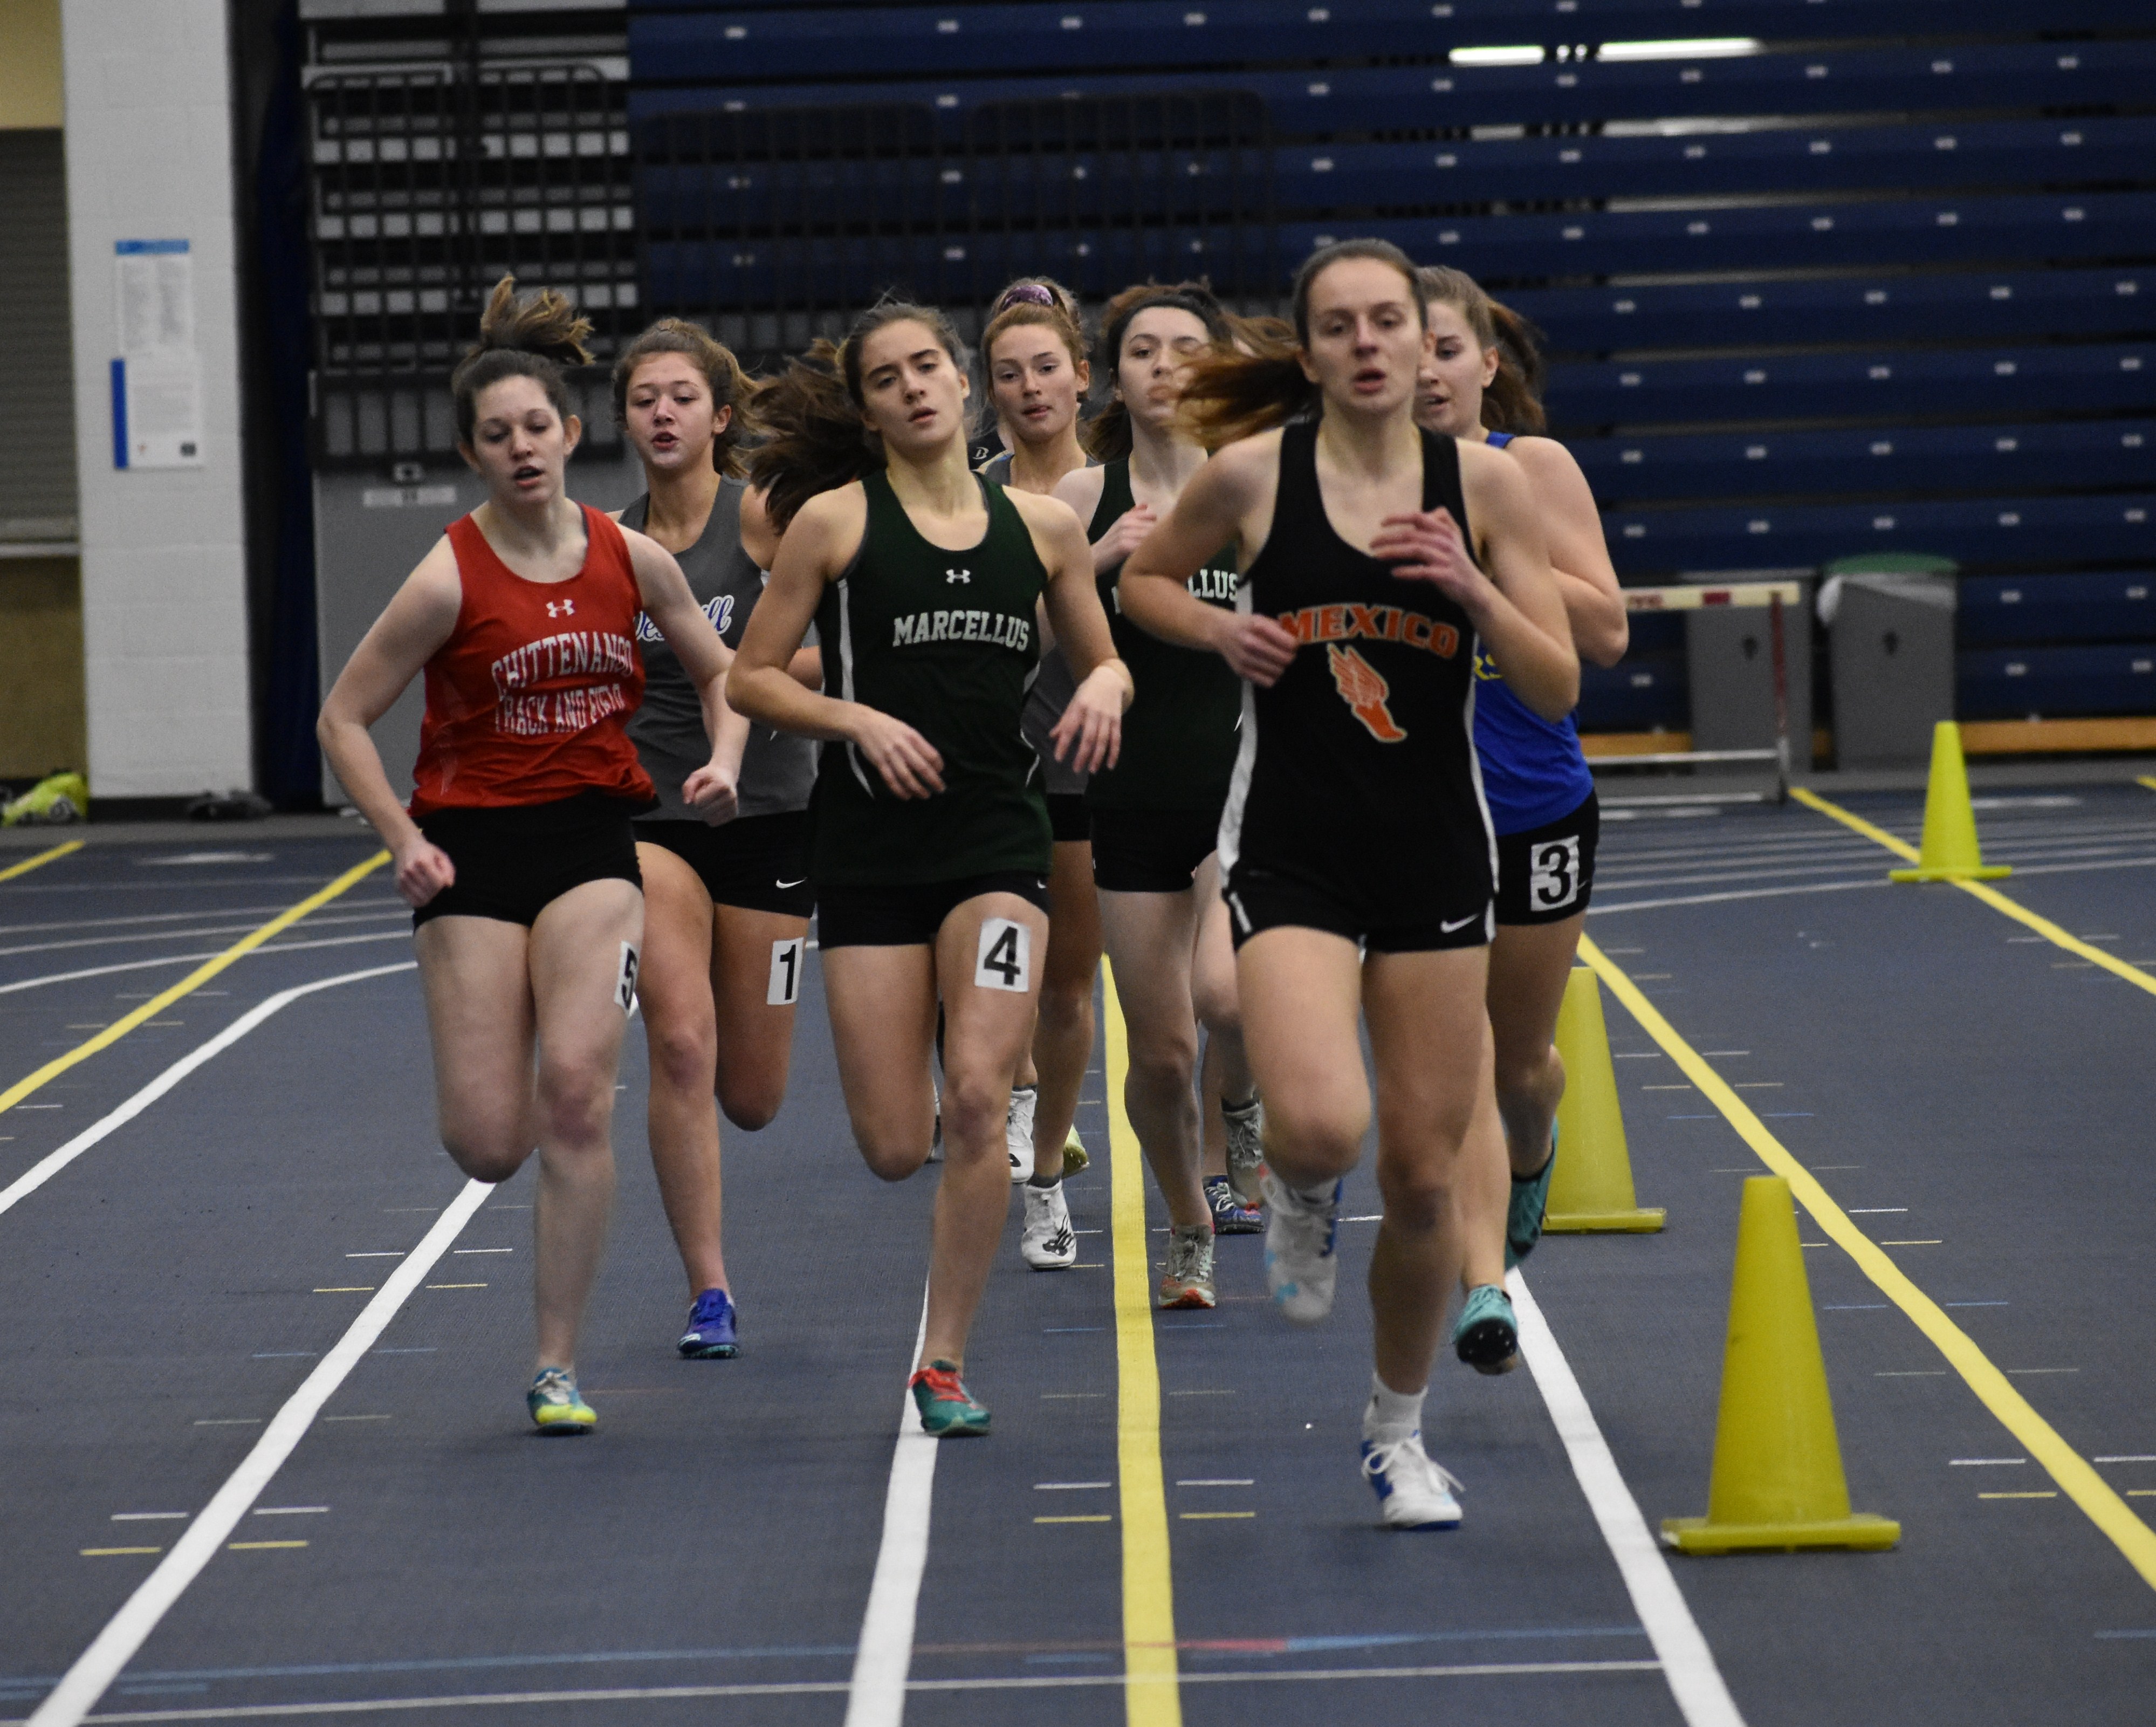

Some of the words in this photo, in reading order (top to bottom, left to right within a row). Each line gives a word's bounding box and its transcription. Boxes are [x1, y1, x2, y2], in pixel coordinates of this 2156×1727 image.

[892, 609, 1030, 652] MARCELLUS
[1278, 602, 1459, 659] MEXICO
[491, 631, 633, 701] CHITTENANGO
[1537, 845, 1571, 904] 3
[621, 948, 638, 1010] 5
[780, 944, 797, 1000] 1
[984, 926, 1021, 986] 4
